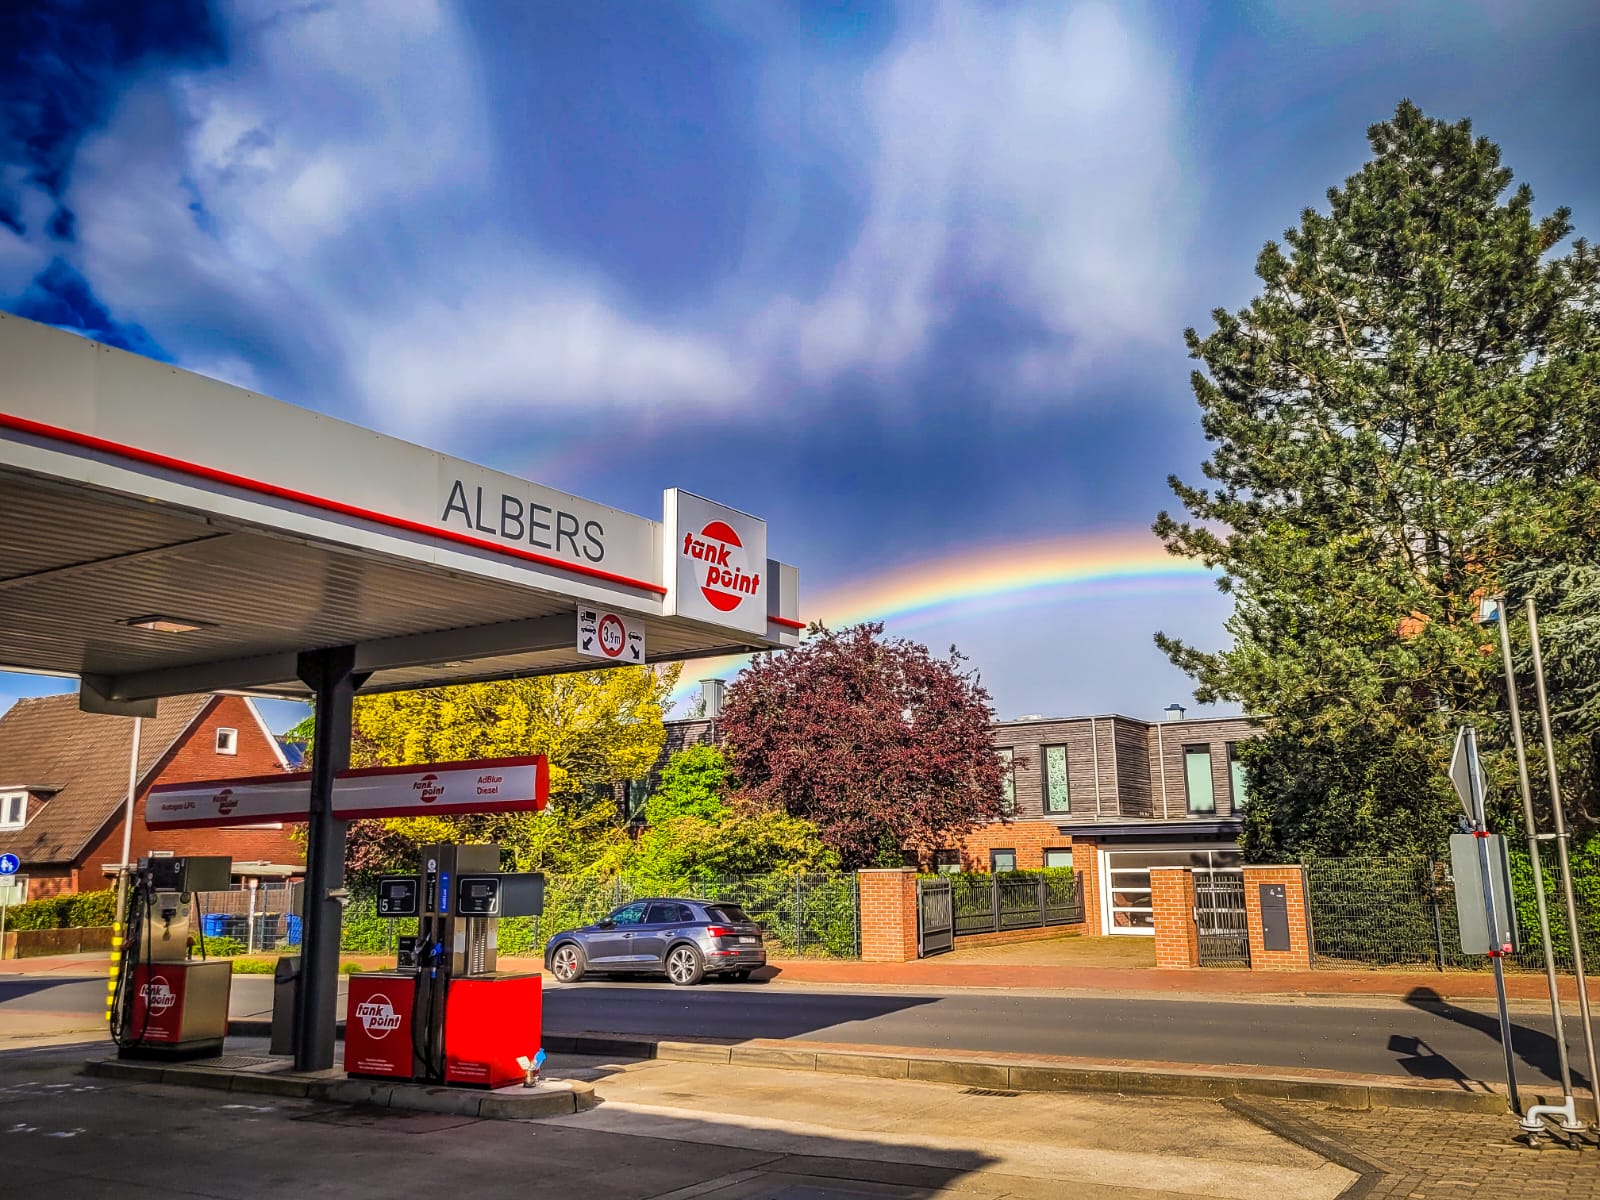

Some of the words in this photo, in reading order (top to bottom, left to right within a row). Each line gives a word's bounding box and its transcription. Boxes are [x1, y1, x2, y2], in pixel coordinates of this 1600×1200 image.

[442, 480, 605, 562] ALBERS
[683, 532, 732, 568] tank
[706, 565, 760, 595] point
[413, 781, 433, 790] tank
[477, 775, 502, 785] AdBlue
[422, 786, 444, 797] point
[476, 786, 498, 795] Diesel
[381, 898, 389, 912] 5
[488, 898, 496, 911] 7
[357, 1004, 385, 1018] tank
[368, 1013, 400, 1028] point
